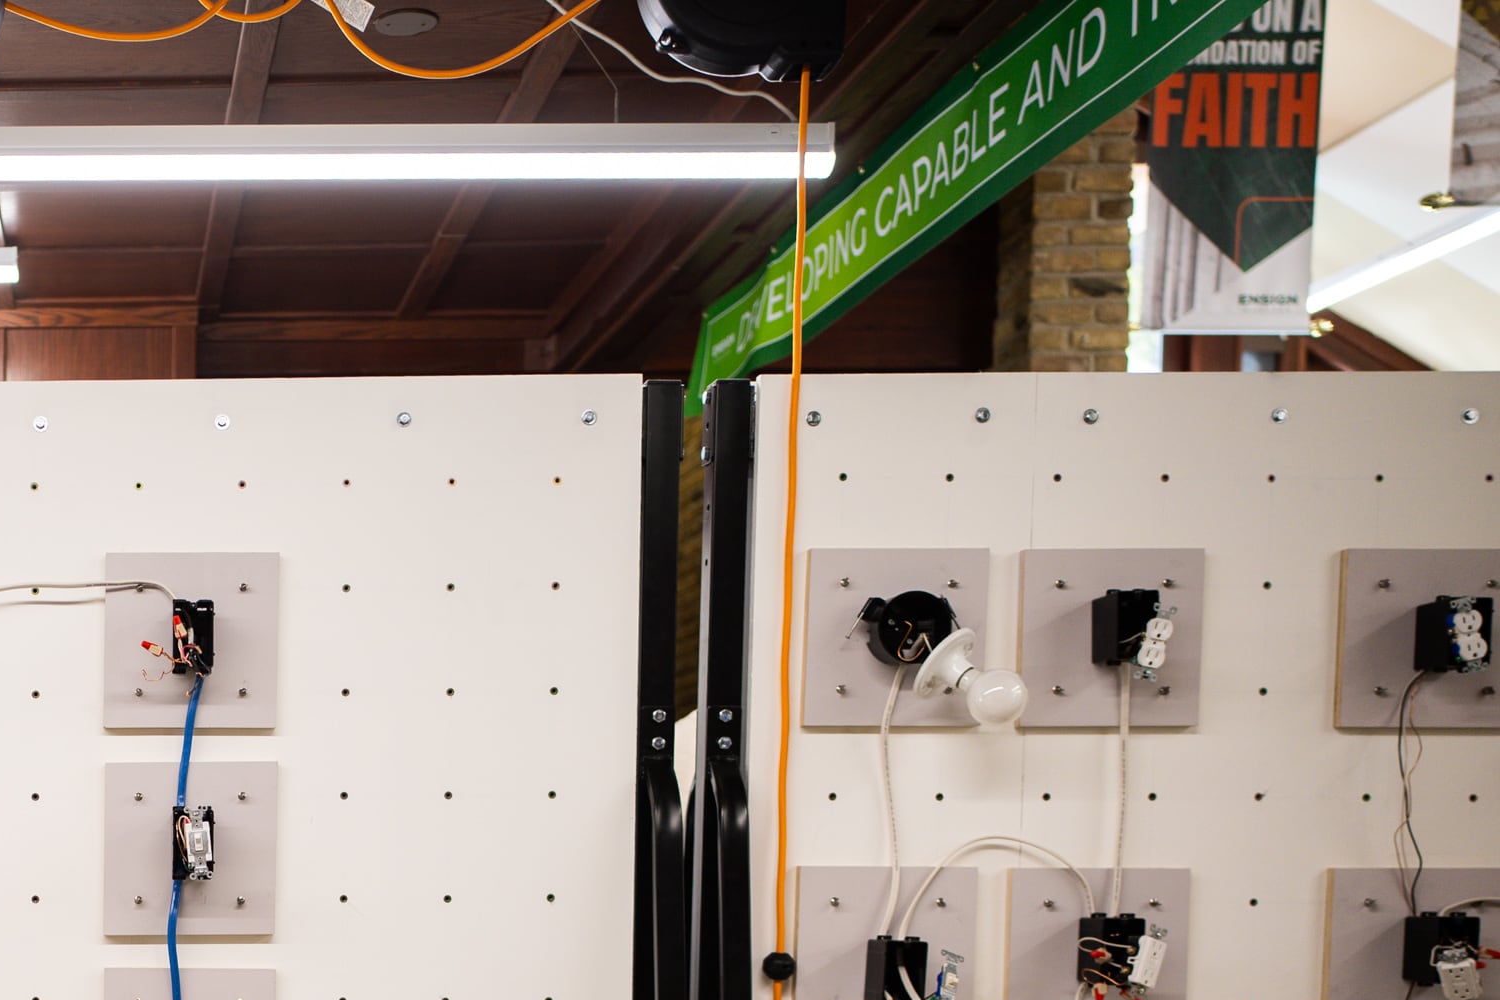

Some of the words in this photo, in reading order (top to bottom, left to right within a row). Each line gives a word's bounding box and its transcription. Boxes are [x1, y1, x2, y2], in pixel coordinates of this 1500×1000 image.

[1300, 0, 1321, 32] A
[1292, 40, 1322, 65] OF
[1151, 72, 1320, 148] FAITH
[736, 207, 867, 353] DVELOPING
[874, 82, 1010, 237] CAPABLE
[1016, 7, 1106, 126] AND
